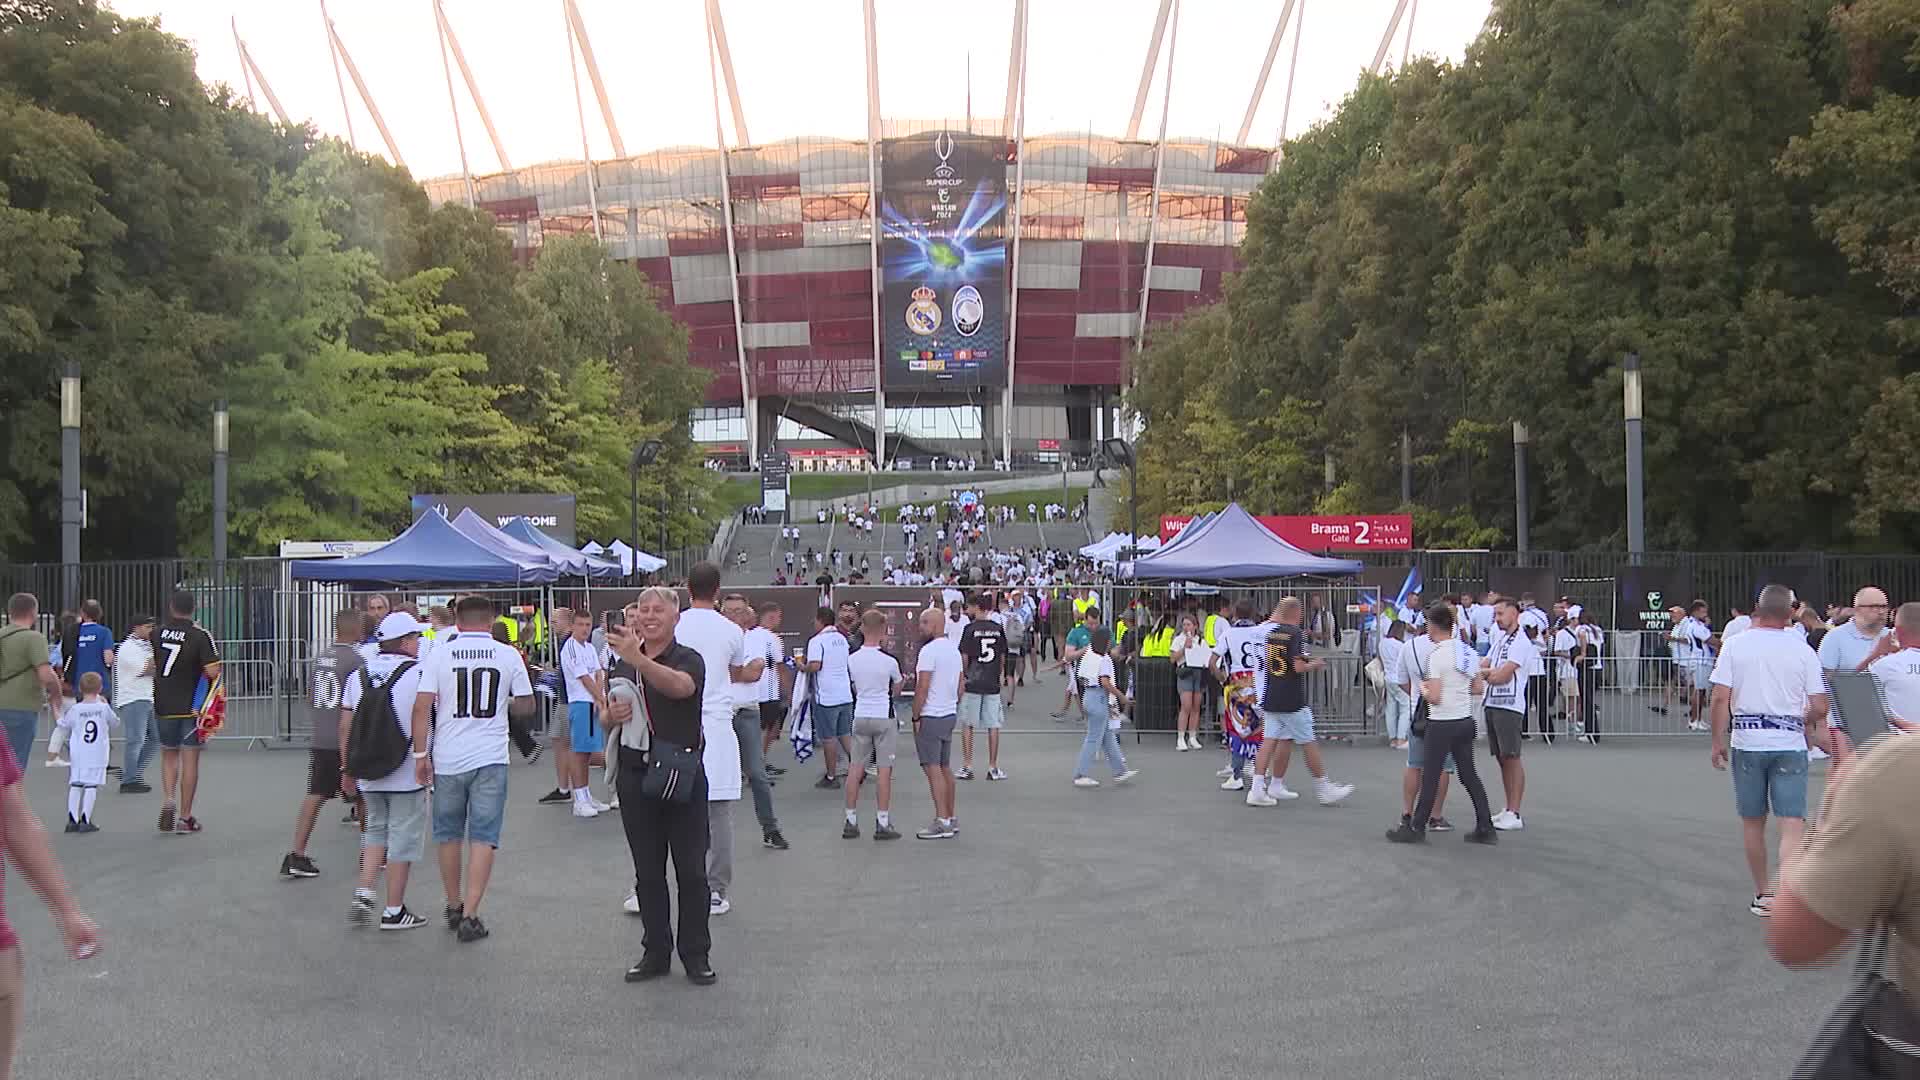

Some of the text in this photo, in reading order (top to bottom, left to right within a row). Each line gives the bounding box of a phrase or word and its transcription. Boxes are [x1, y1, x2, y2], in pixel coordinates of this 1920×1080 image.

[1311, 521, 1370, 544] Brama 2
[1331, 534, 1350, 543] Gate
[1639, 611, 1671, 621] WARSAW
[1646, 621, 1665, 629] 2024
[160, 629, 186, 641] RAUL
[161, 642, 182, 677] 7
[977, 638, 996, 663] 5
[313, 670, 342, 709] 10
[452, 667, 501, 719] 10
[83, 720, 98, 744] 9
